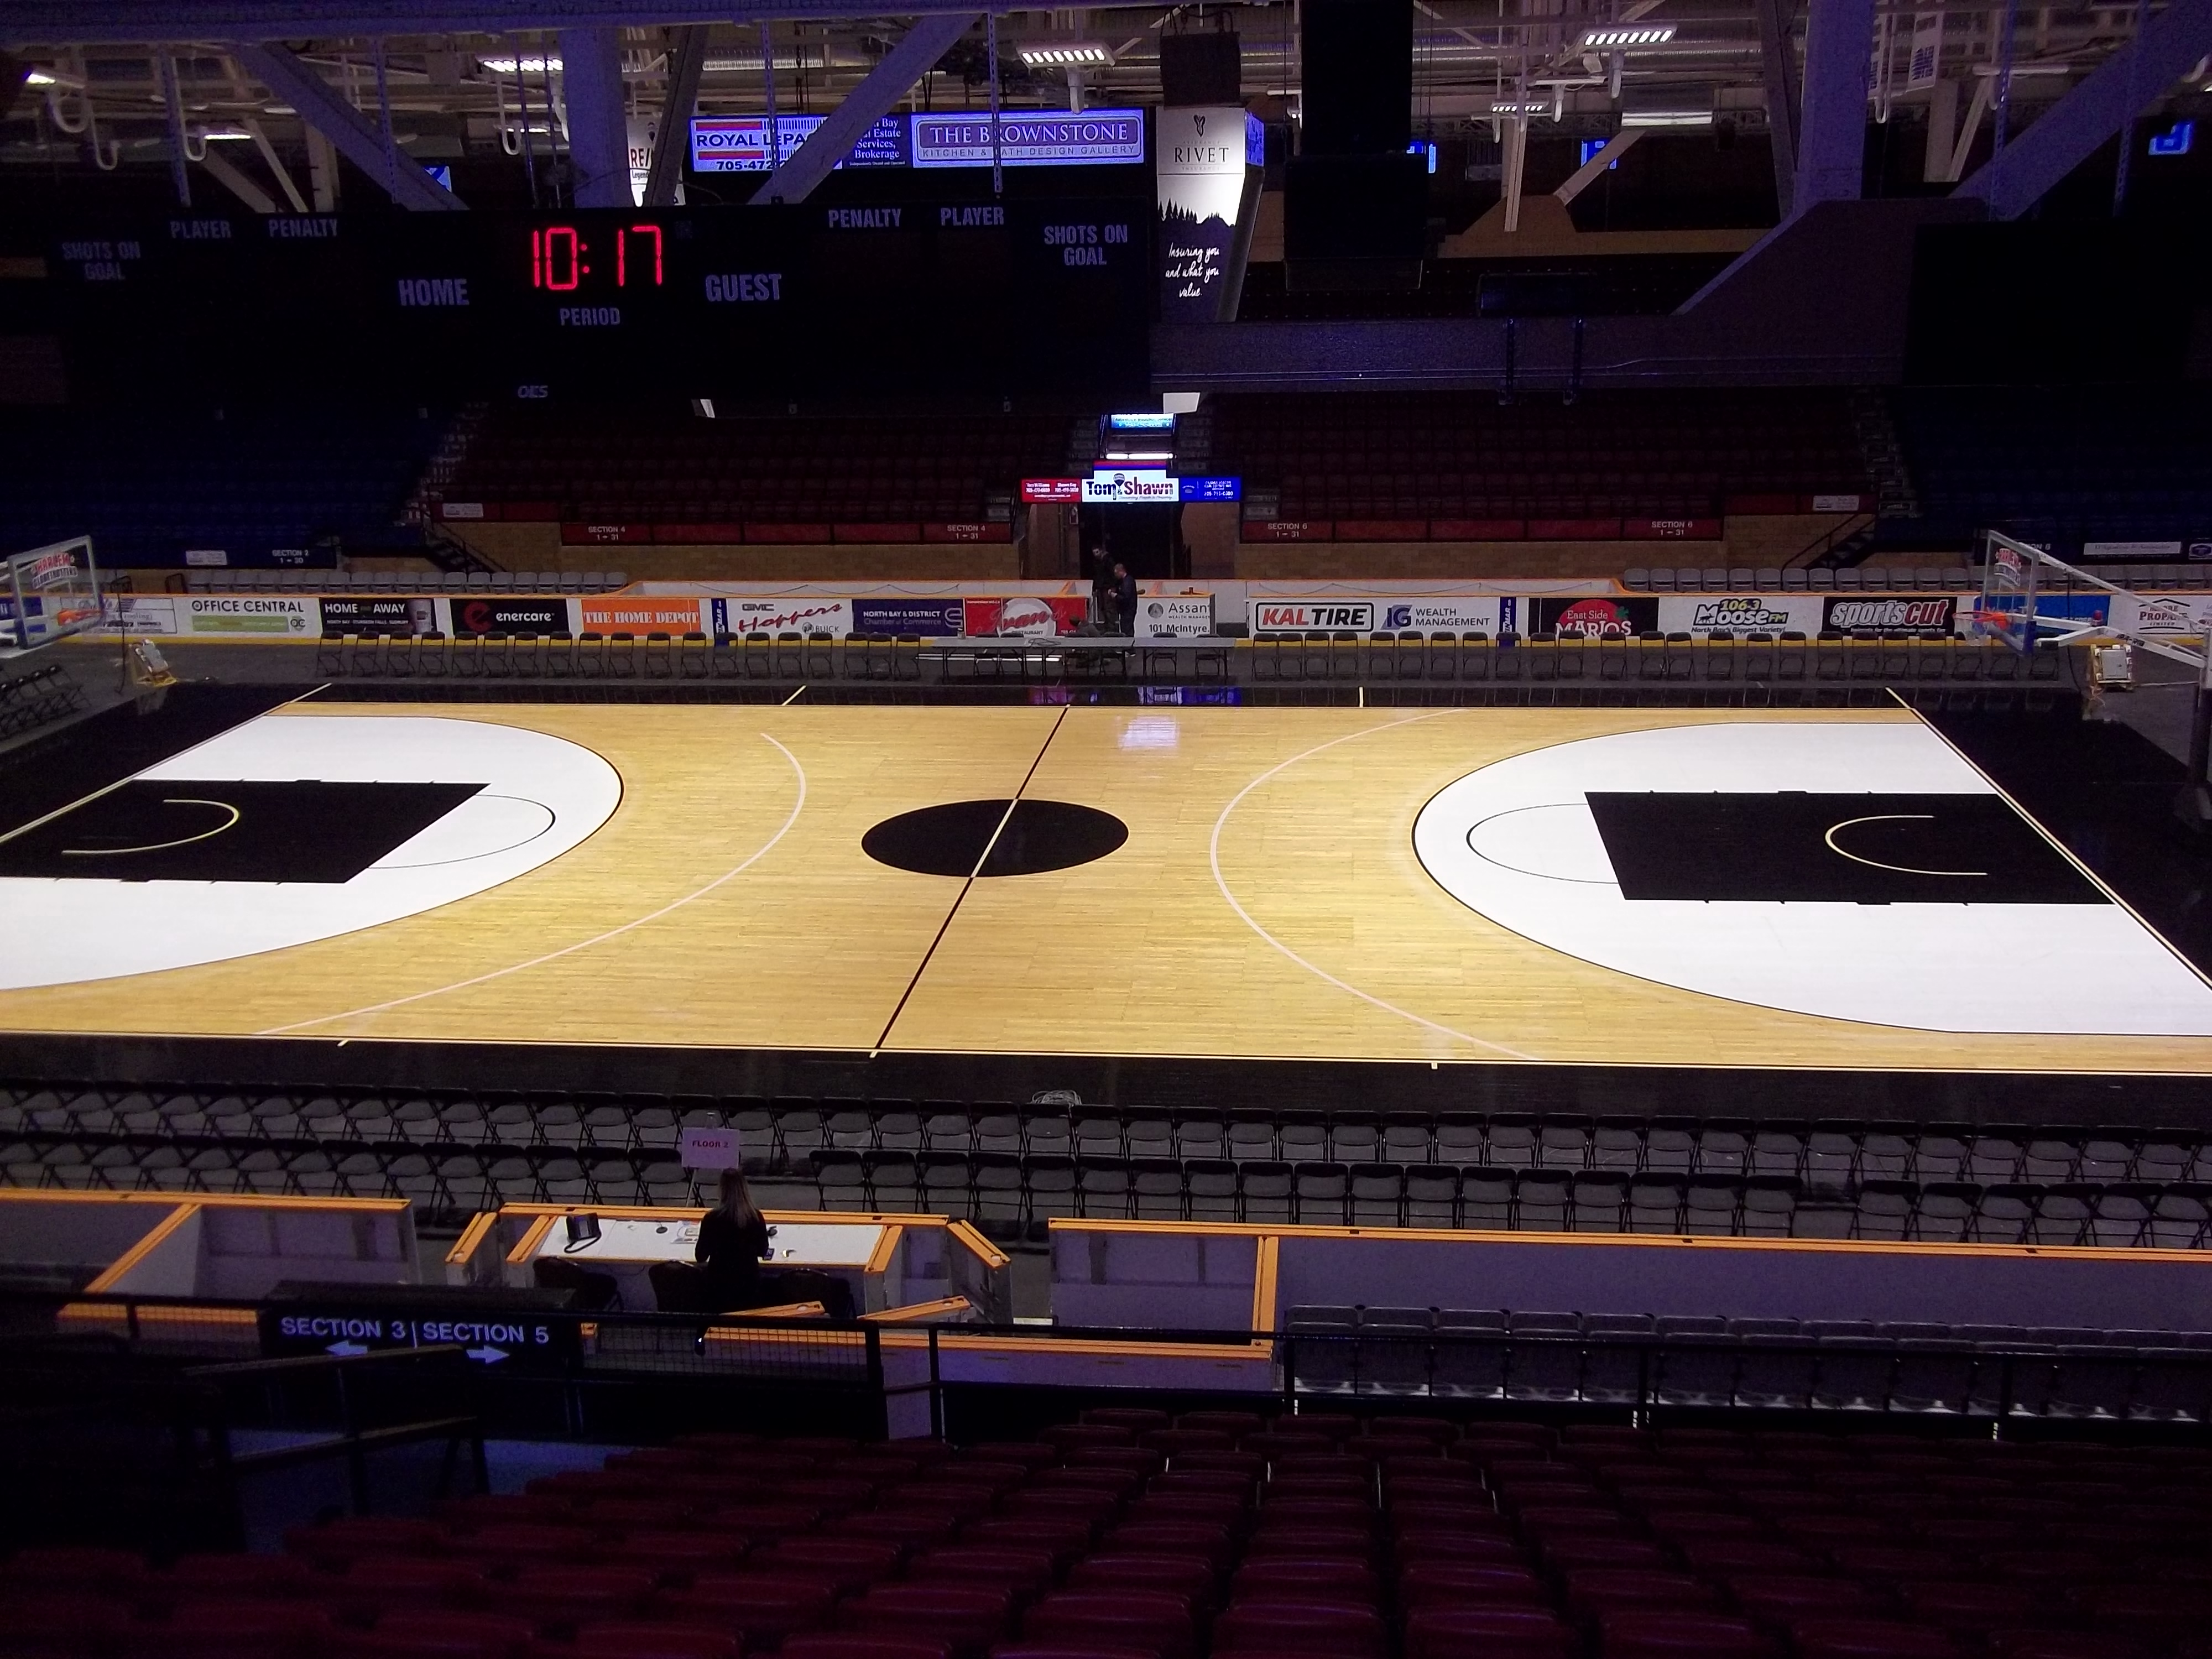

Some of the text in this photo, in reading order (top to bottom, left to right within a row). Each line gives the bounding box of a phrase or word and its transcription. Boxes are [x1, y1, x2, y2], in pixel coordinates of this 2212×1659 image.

[874, 128, 901, 137] Estate
[881, 118, 899, 129] Bay
[696, 133, 806, 147] ROYAL LEPA
[857, 139, 895, 149] Services,
[929, 126, 972, 144] THE
[854, 149, 900, 160] Brokerage
[922, 145, 1135, 158] KITCHEN & ATH DESIGN GALLERY
[1174, 147, 1229, 163] RIVET
[828, 208, 902, 228] PENALTY
[940, 207, 1005, 226] PLAYER
[170, 220, 232, 239] PLAYER
[269, 219, 338, 238] PENALTY
[1044, 224, 1129, 245] SHOTS ON
[62, 241, 141, 260] SHOTS ON
[533, 225, 663, 290] 10:17
[1063, 247, 1108, 267] GOAL
[1168, 242, 1219, 263] Insuring you
[84, 262, 126, 280] GOAL
[1165, 260, 1219, 284] and what you
[398, 278, 470, 307] HOME
[705, 273, 782, 302] GUEST
[559, 307, 621, 326] PERIOD
[517, 385, 549, 399] OES
[1086, 481, 1117, 500] Tom
[1124, 476, 1173, 495] Shawn
[191, 600, 304, 612] OFFICE CENTRAL
[324, 603, 406, 614] HOME AWAY
[742, 603, 775, 612] GMC
[1168, 602, 1209, 613] Assan
[1416, 608, 1457, 616] WEALTH
[1567, 609, 1608, 619] East Side
[1693, 604, 1787, 625] Moose FM
[1829, 599, 1949, 628] sportscut
[495, 611, 552, 622] enercare
[583, 611, 700, 624] THE HOME DEPOT
[1262, 608, 1368, 625] KAL TIRE
[1386, 607, 1412, 628] IG
[1416, 617, 1490, 627] MANAGEMENT
[1149, 624, 1162, 633] 101
[281, 1316, 550, 1344] SECTION 3 SECTION 5
